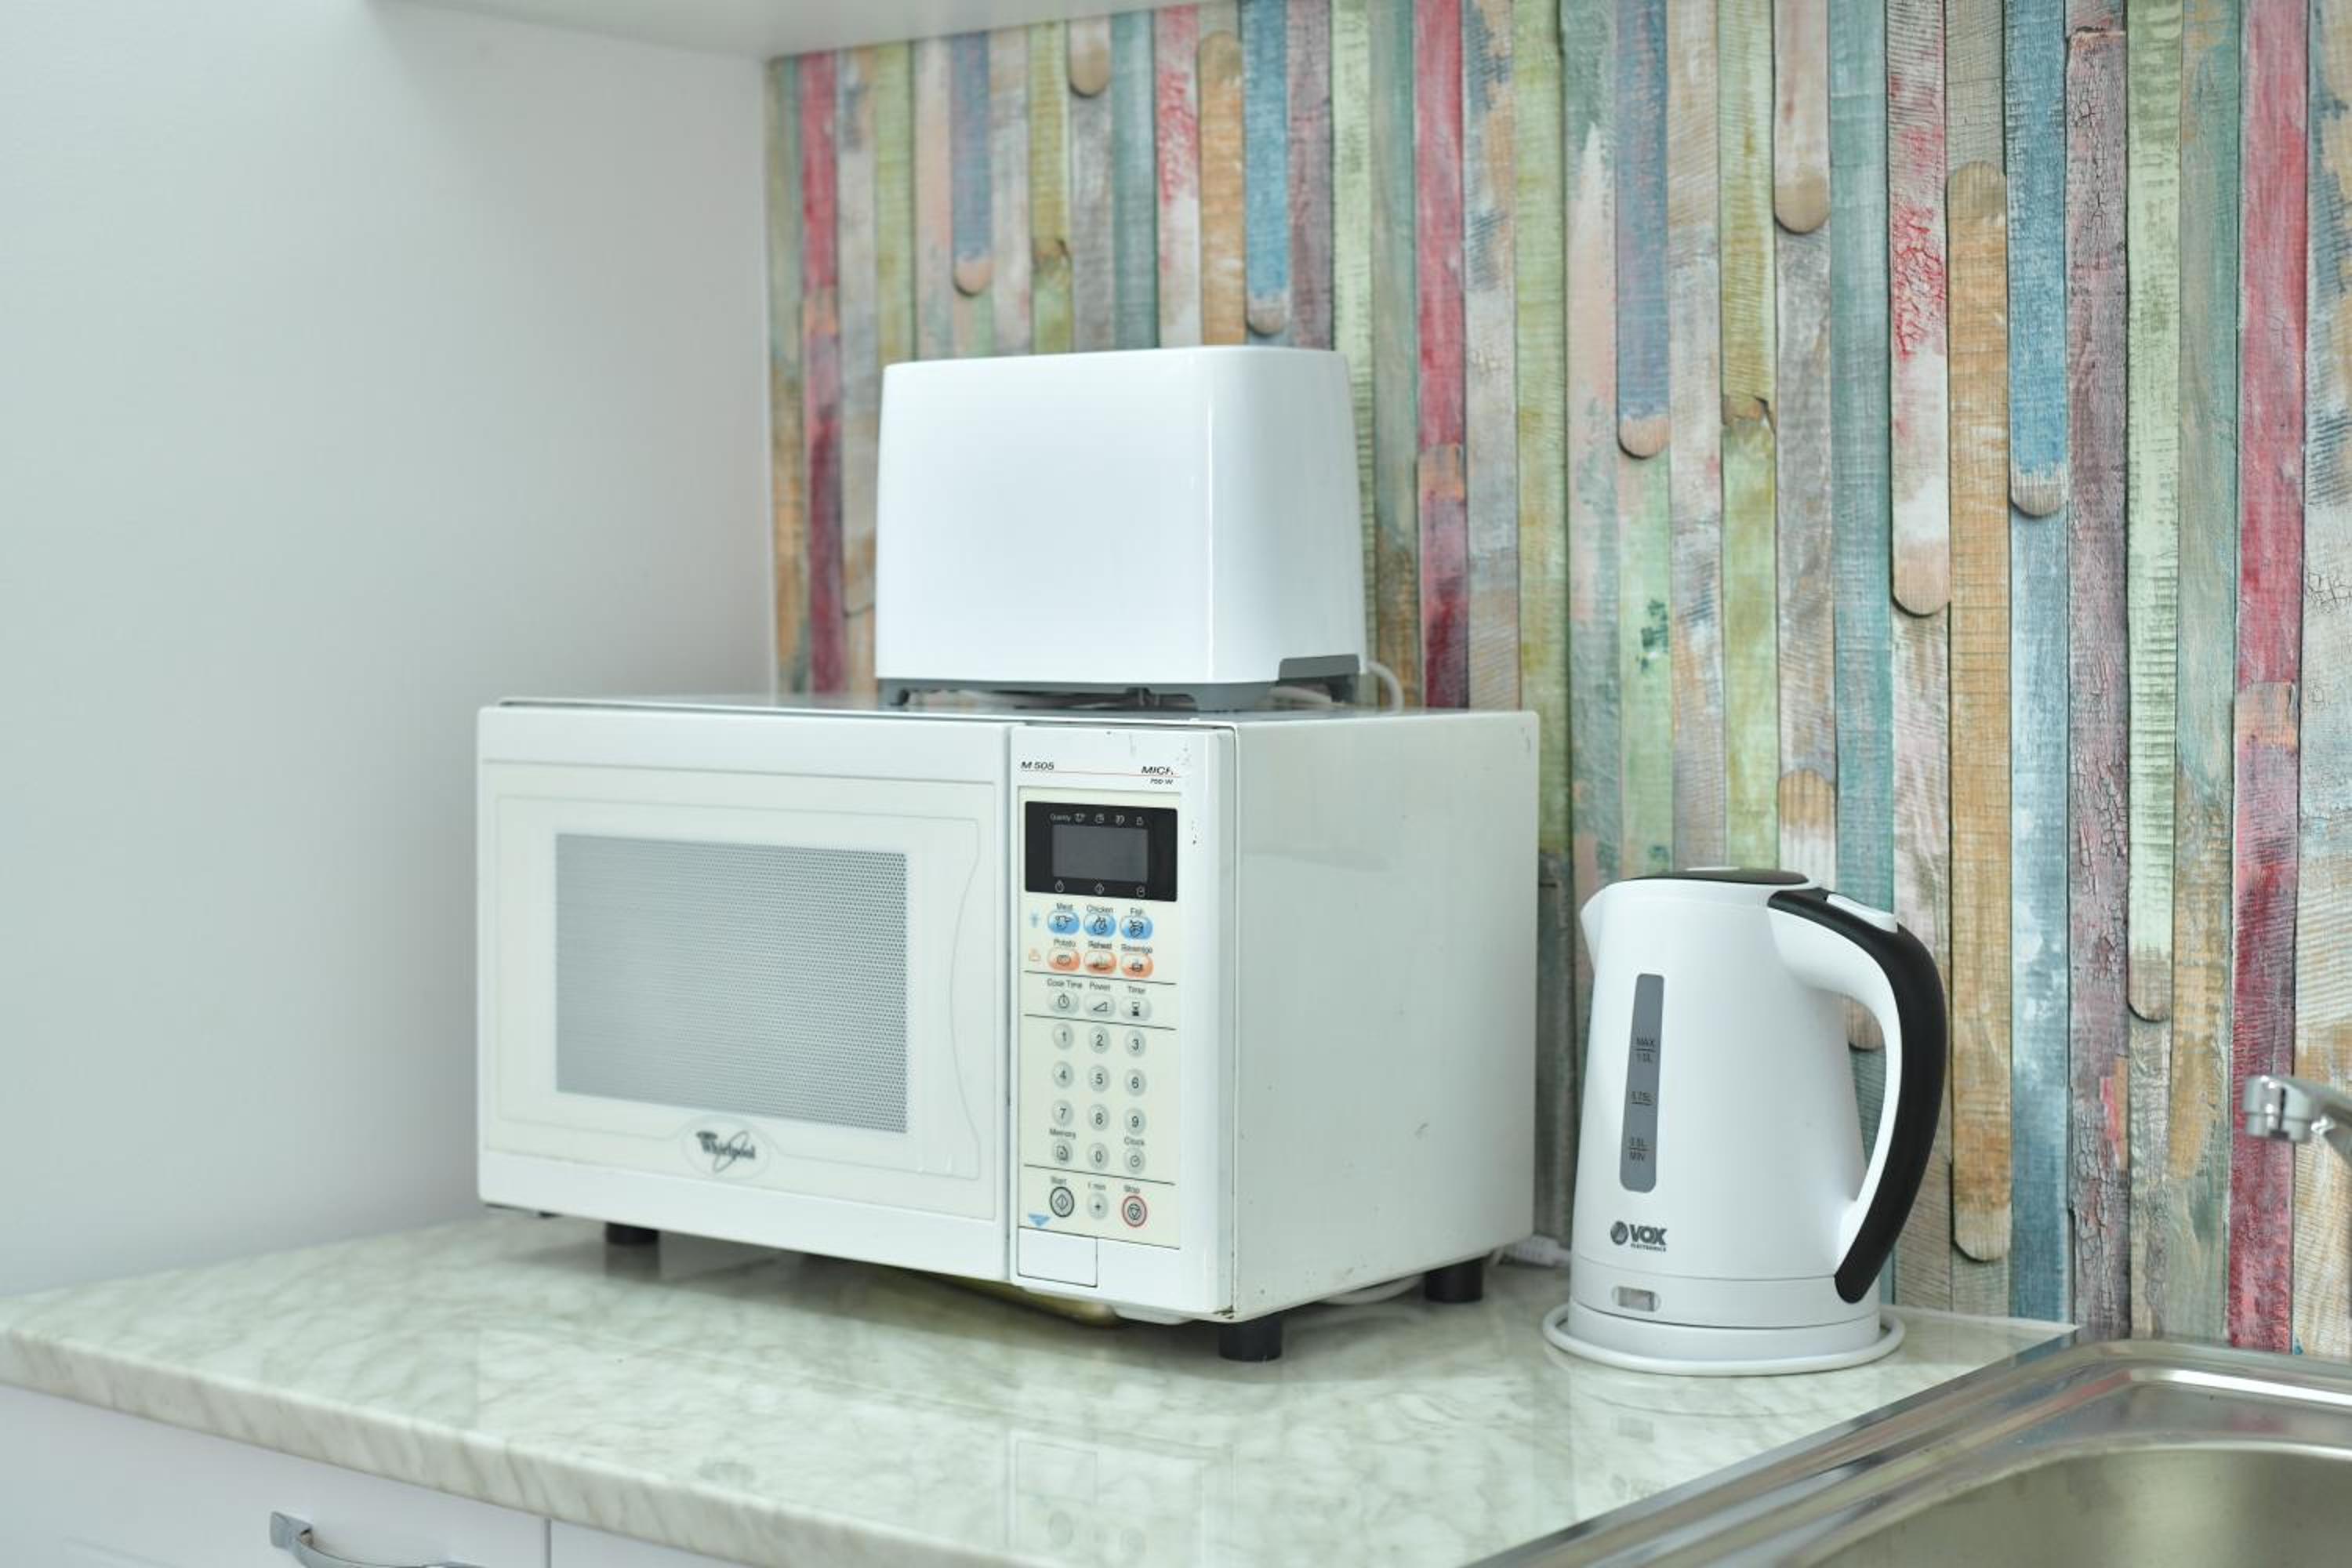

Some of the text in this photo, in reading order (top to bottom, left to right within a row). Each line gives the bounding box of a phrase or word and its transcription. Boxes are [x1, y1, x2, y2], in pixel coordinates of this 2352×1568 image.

[1034, 762, 1054, 771] 505
[1086, 905, 1114, 913] Chicken
[1121, 944, 1153, 954] Beverage
[1066, 980, 1083, 989] Time
[1089, 982, 1111, 991] Power
[1127, 985, 1145, 994] Timer
[1096, 1034, 1103, 1046] 2
[1131, 1038, 1139, 1051] 3
[1636, 1036, 1655, 1047] MAX
[1059, 1070, 1067, 1080] 4
[1096, 1073, 1103, 1085] 5
[1131, 1076, 1139, 1089] 6
[1059, 1108, 1066, 1119] 7
[1095, 1112, 1103, 1125] 8
[1131, 1116, 1139, 1128] 9
[1049, 1128, 1076, 1139] Memory
[1123, 1136, 1145, 1145] Clock
[695, 1131, 756, 1170] Whirlpool
[1629, 1151, 1646, 1161] MIN
[1095, 1150, 1102, 1163] 0
[1124, 1185, 1141, 1193] Stop
[1629, 1224, 1668, 1246] VOX
